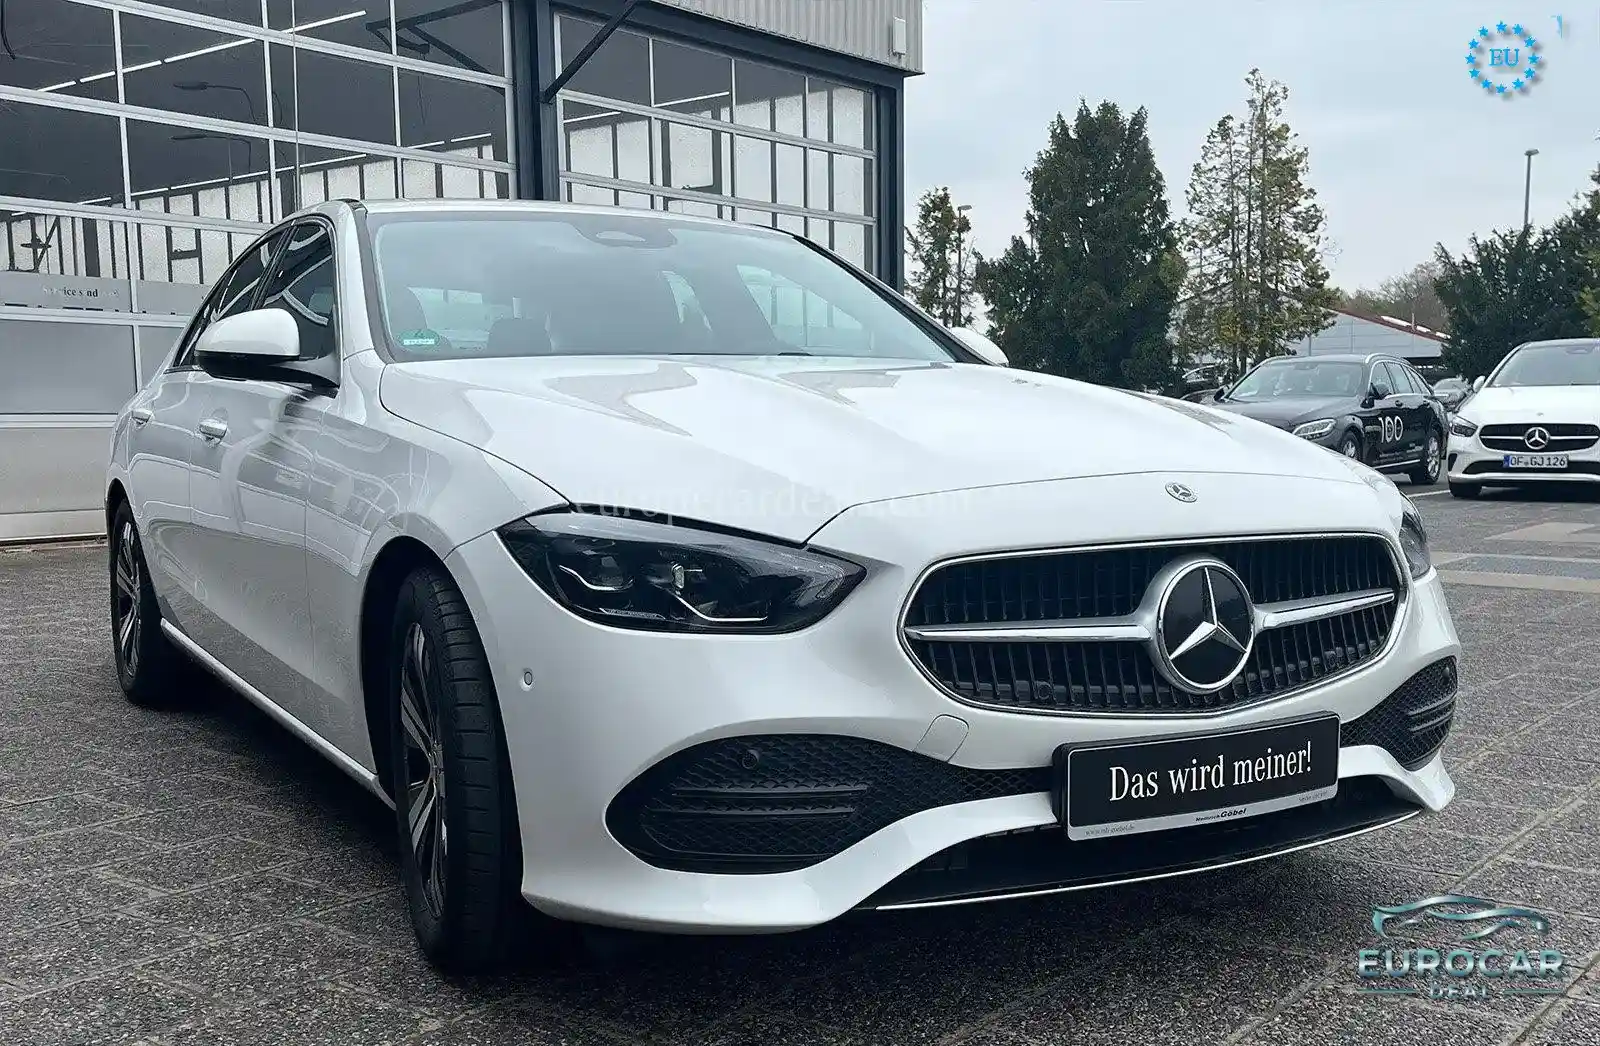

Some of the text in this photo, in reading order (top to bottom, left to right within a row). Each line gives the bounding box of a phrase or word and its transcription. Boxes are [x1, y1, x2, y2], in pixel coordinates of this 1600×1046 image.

[1378, 416, 1403, 443] 100
[1109, 740, 1312, 802] Das wird meiner!
